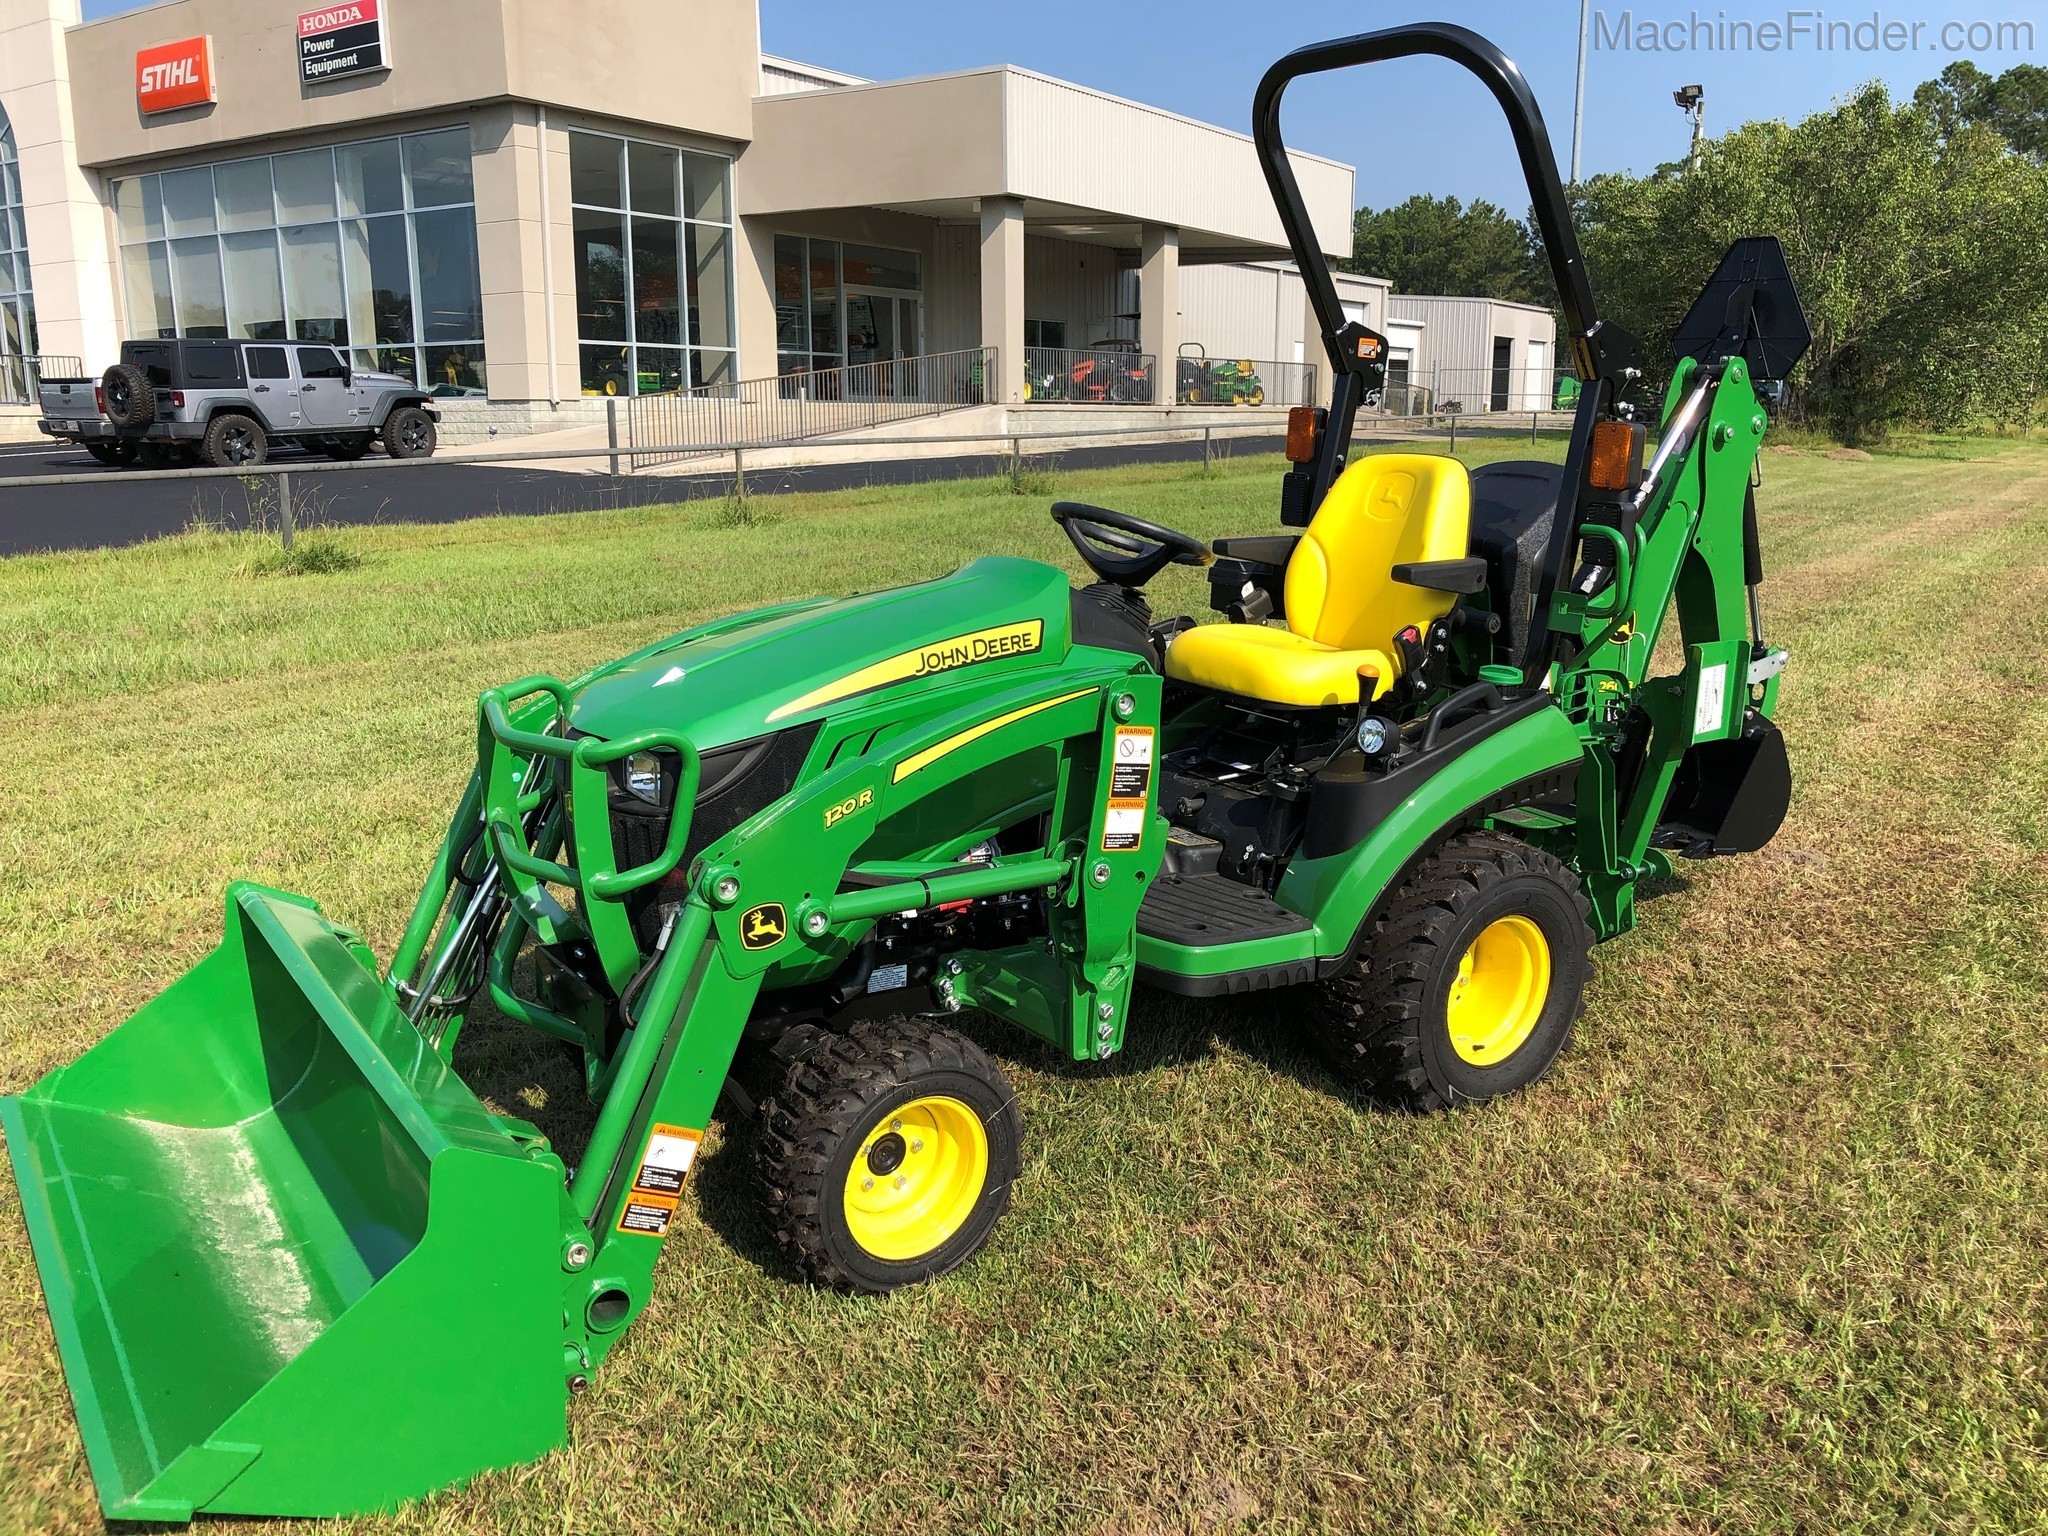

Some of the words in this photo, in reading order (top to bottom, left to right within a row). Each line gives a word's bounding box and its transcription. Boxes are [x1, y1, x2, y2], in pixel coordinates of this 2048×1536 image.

[302, 6, 363, 32] HONDA
[303, 38, 335, 54] Power
[140, 57, 199, 93] STIHL
[305, 52, 359, 76] Equipment
[915, 645, 969, 674] JOHN
[972, 632, 1033, 659] DEERE
[1123, 728, 1152, 736] WARNING
[824, 796, 857, 829] 120
[859, 789, 873, 808] R
[666, 1128, 697, 1140] WARNING
[641, 1197, 673, 1208] WARNING
